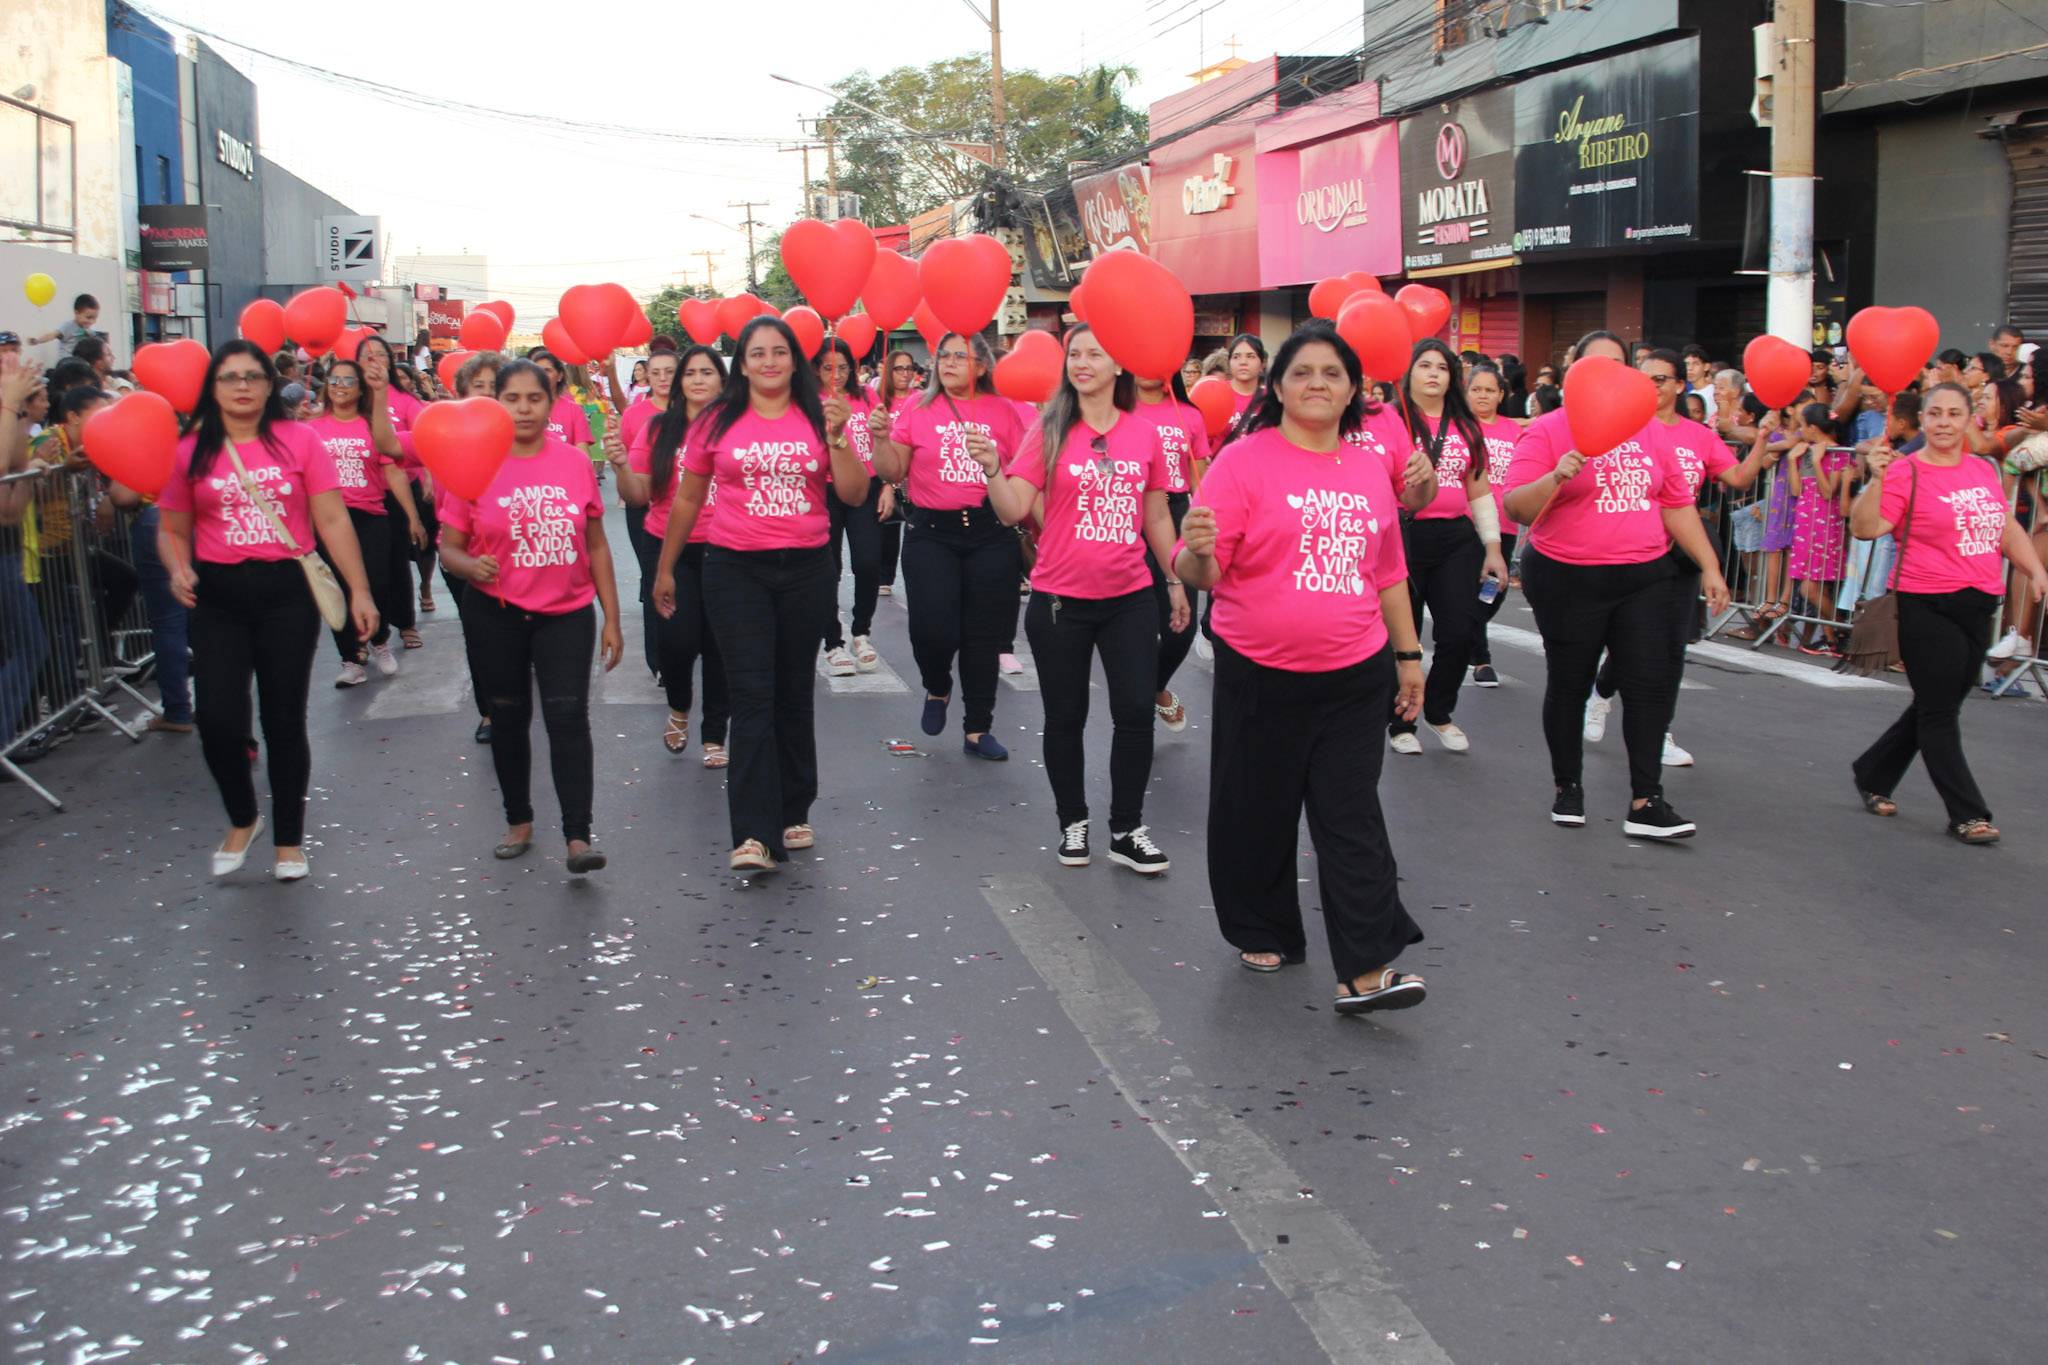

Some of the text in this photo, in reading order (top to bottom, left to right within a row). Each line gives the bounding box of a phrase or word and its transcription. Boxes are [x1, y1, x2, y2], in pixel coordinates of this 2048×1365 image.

[1554, 95, 1623, 144] Aryane
[1580, 132, 1649, 168] RIBEIRO
[1297, 179, 1367, 232] ORIGINAL
[1419, 179, 1488, 225] MORATA
[177, 238, 208, 248] MAKES
[330, 226, 339, 271] STUDIO
[428, 316, 463, 328] ROPICAL
[548, 423, 563, 432] OR
[747, 442, 811, 457] AMOR
[742, 452, 802, 480] Mãe
[944, 459, 954, 471] A
[1084, 459, 1142, 477] AOR
[340, 478, 359, 488] DA!
[760, 475, 807, 491] PARA
[1079, 468, 1133, 502] DE Mãe
[1610, 470, 1652, 487] PARA
[513, 486, 569, 501] AMOR
[751, 487, 806, 504] A VIDA
[1304, 488, 1371, 513] AMOR
[1601, 485, 1613, 500] A
[509, 495, 567, 524] DE Mãe
[745, 501, 797, 517] TODA!
[1094, 496, 1138, 515] PARA
[1081, 511, 1134, 529] A VIDA
[1301, 503, 1365, 542] DE Mãe
[527, 521, 576, 538] PARA
[1075, 524, 1124, 544] TODA!
[1962, 529, 1972, 543] A
[518, 536, 573, 553] A VIDA
[1299, 529, 1367, 560] É PARA
[511, 550, 564, 568] TODA!
[1301, 554, 1361, 577] A VIDA
[1293, 571, 1351, 595] TODA!
